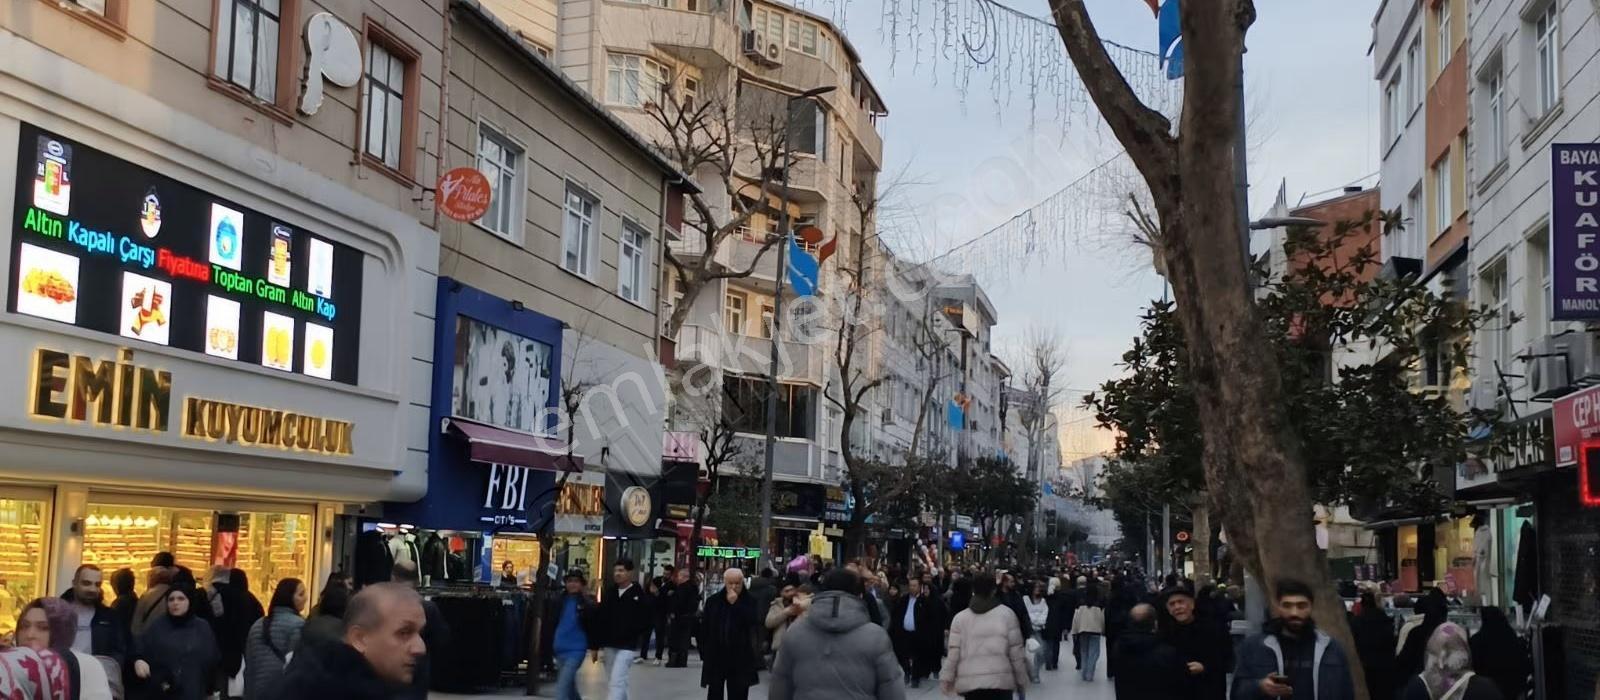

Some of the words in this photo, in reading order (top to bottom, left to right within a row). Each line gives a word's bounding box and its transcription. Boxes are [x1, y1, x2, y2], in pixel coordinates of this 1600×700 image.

[1560, 149, 1600, 165] BAYA
[25, 207, 62, 240] Altın
[68, 221, 115, 255] Kapalı
[120, 237, 155, 269] Çarşı
[158, 248, 209, 283] Fiyatına
[213, 265, 252, 295] Toptan
[256, 278, 286, 303] Gram
[292, 290, 314, 312] Altın
[317, 298, 335, 321] Kap
[1573, 170, 1599, 293] KUAFÖR
[32, 347, 172, 432] EMİN
[181, 395, 355, 456] KUYUMCULUK
[1573, 395, 1591, 428] CEP
[484, 463, 529, 511] FBI
